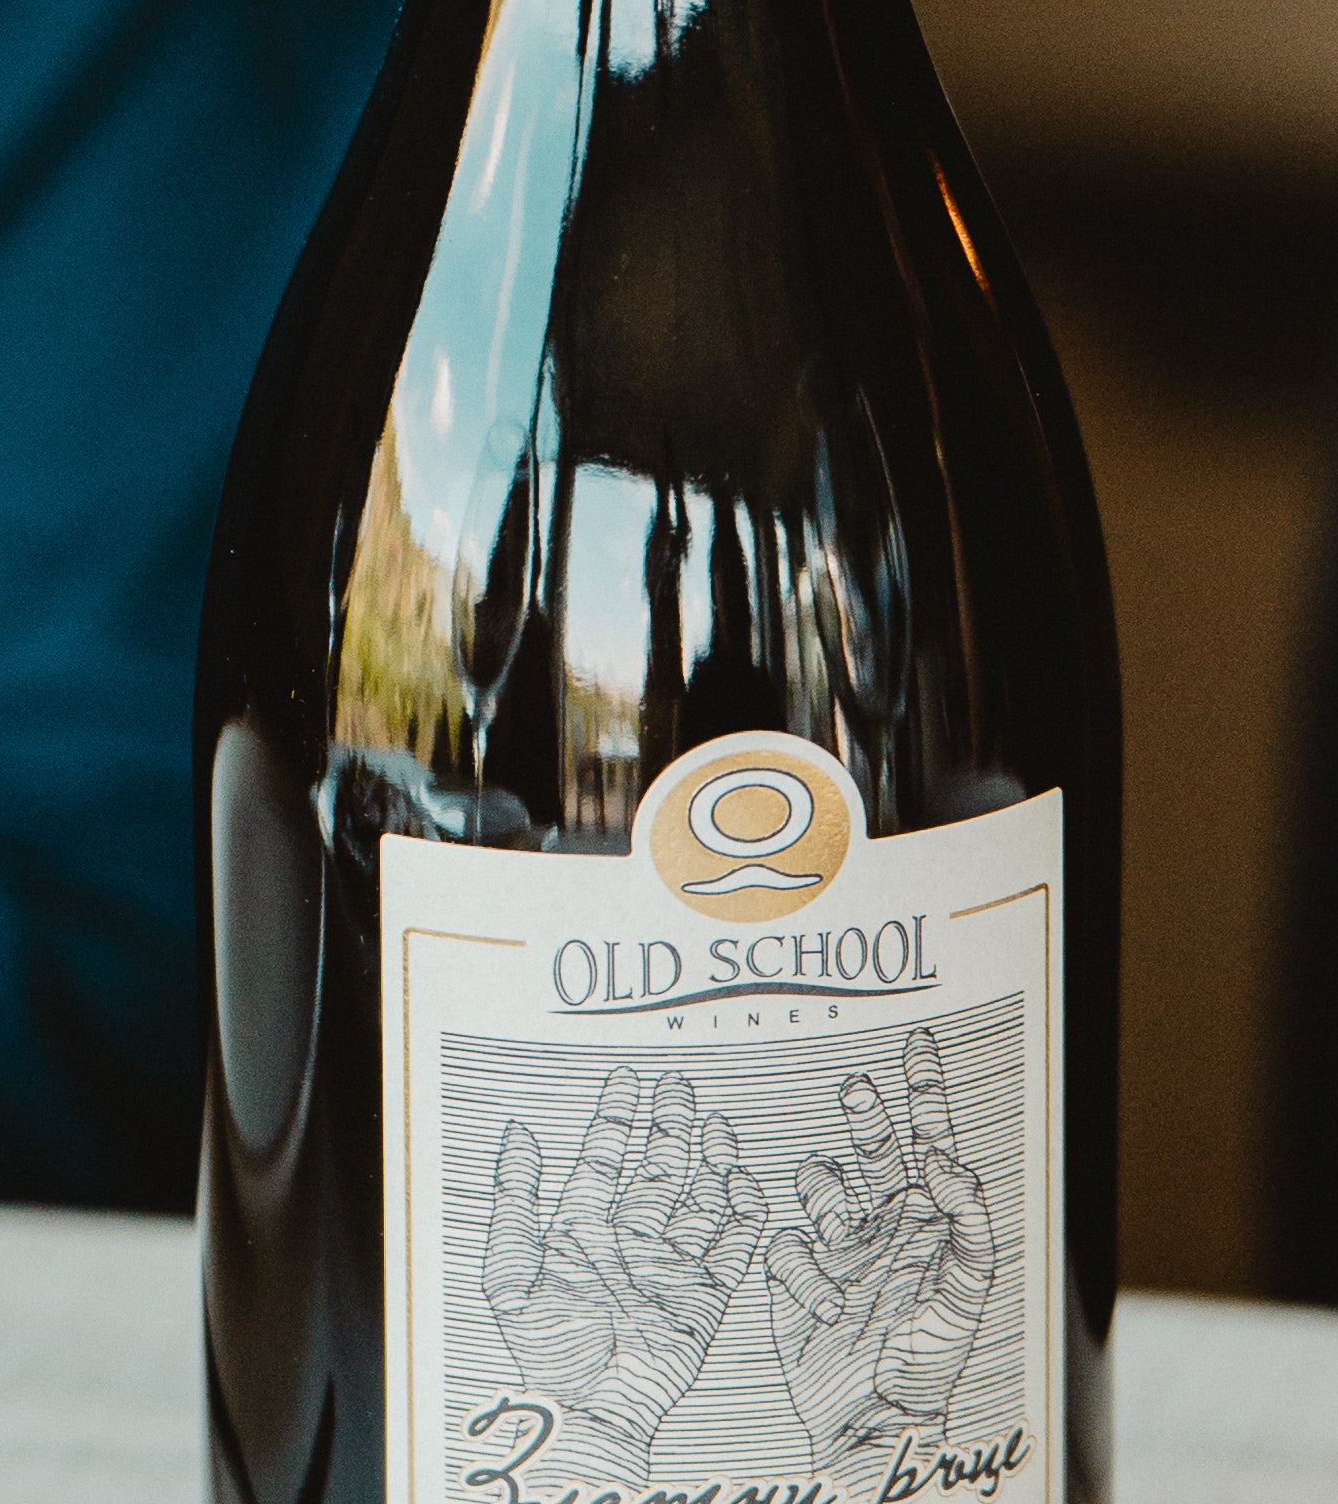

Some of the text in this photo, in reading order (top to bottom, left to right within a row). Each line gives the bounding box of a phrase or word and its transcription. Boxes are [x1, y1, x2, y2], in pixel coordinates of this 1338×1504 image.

[552, 914, 938, 1007] OLD SCHOOL
[666, 1004, 840, 1030] WINES
